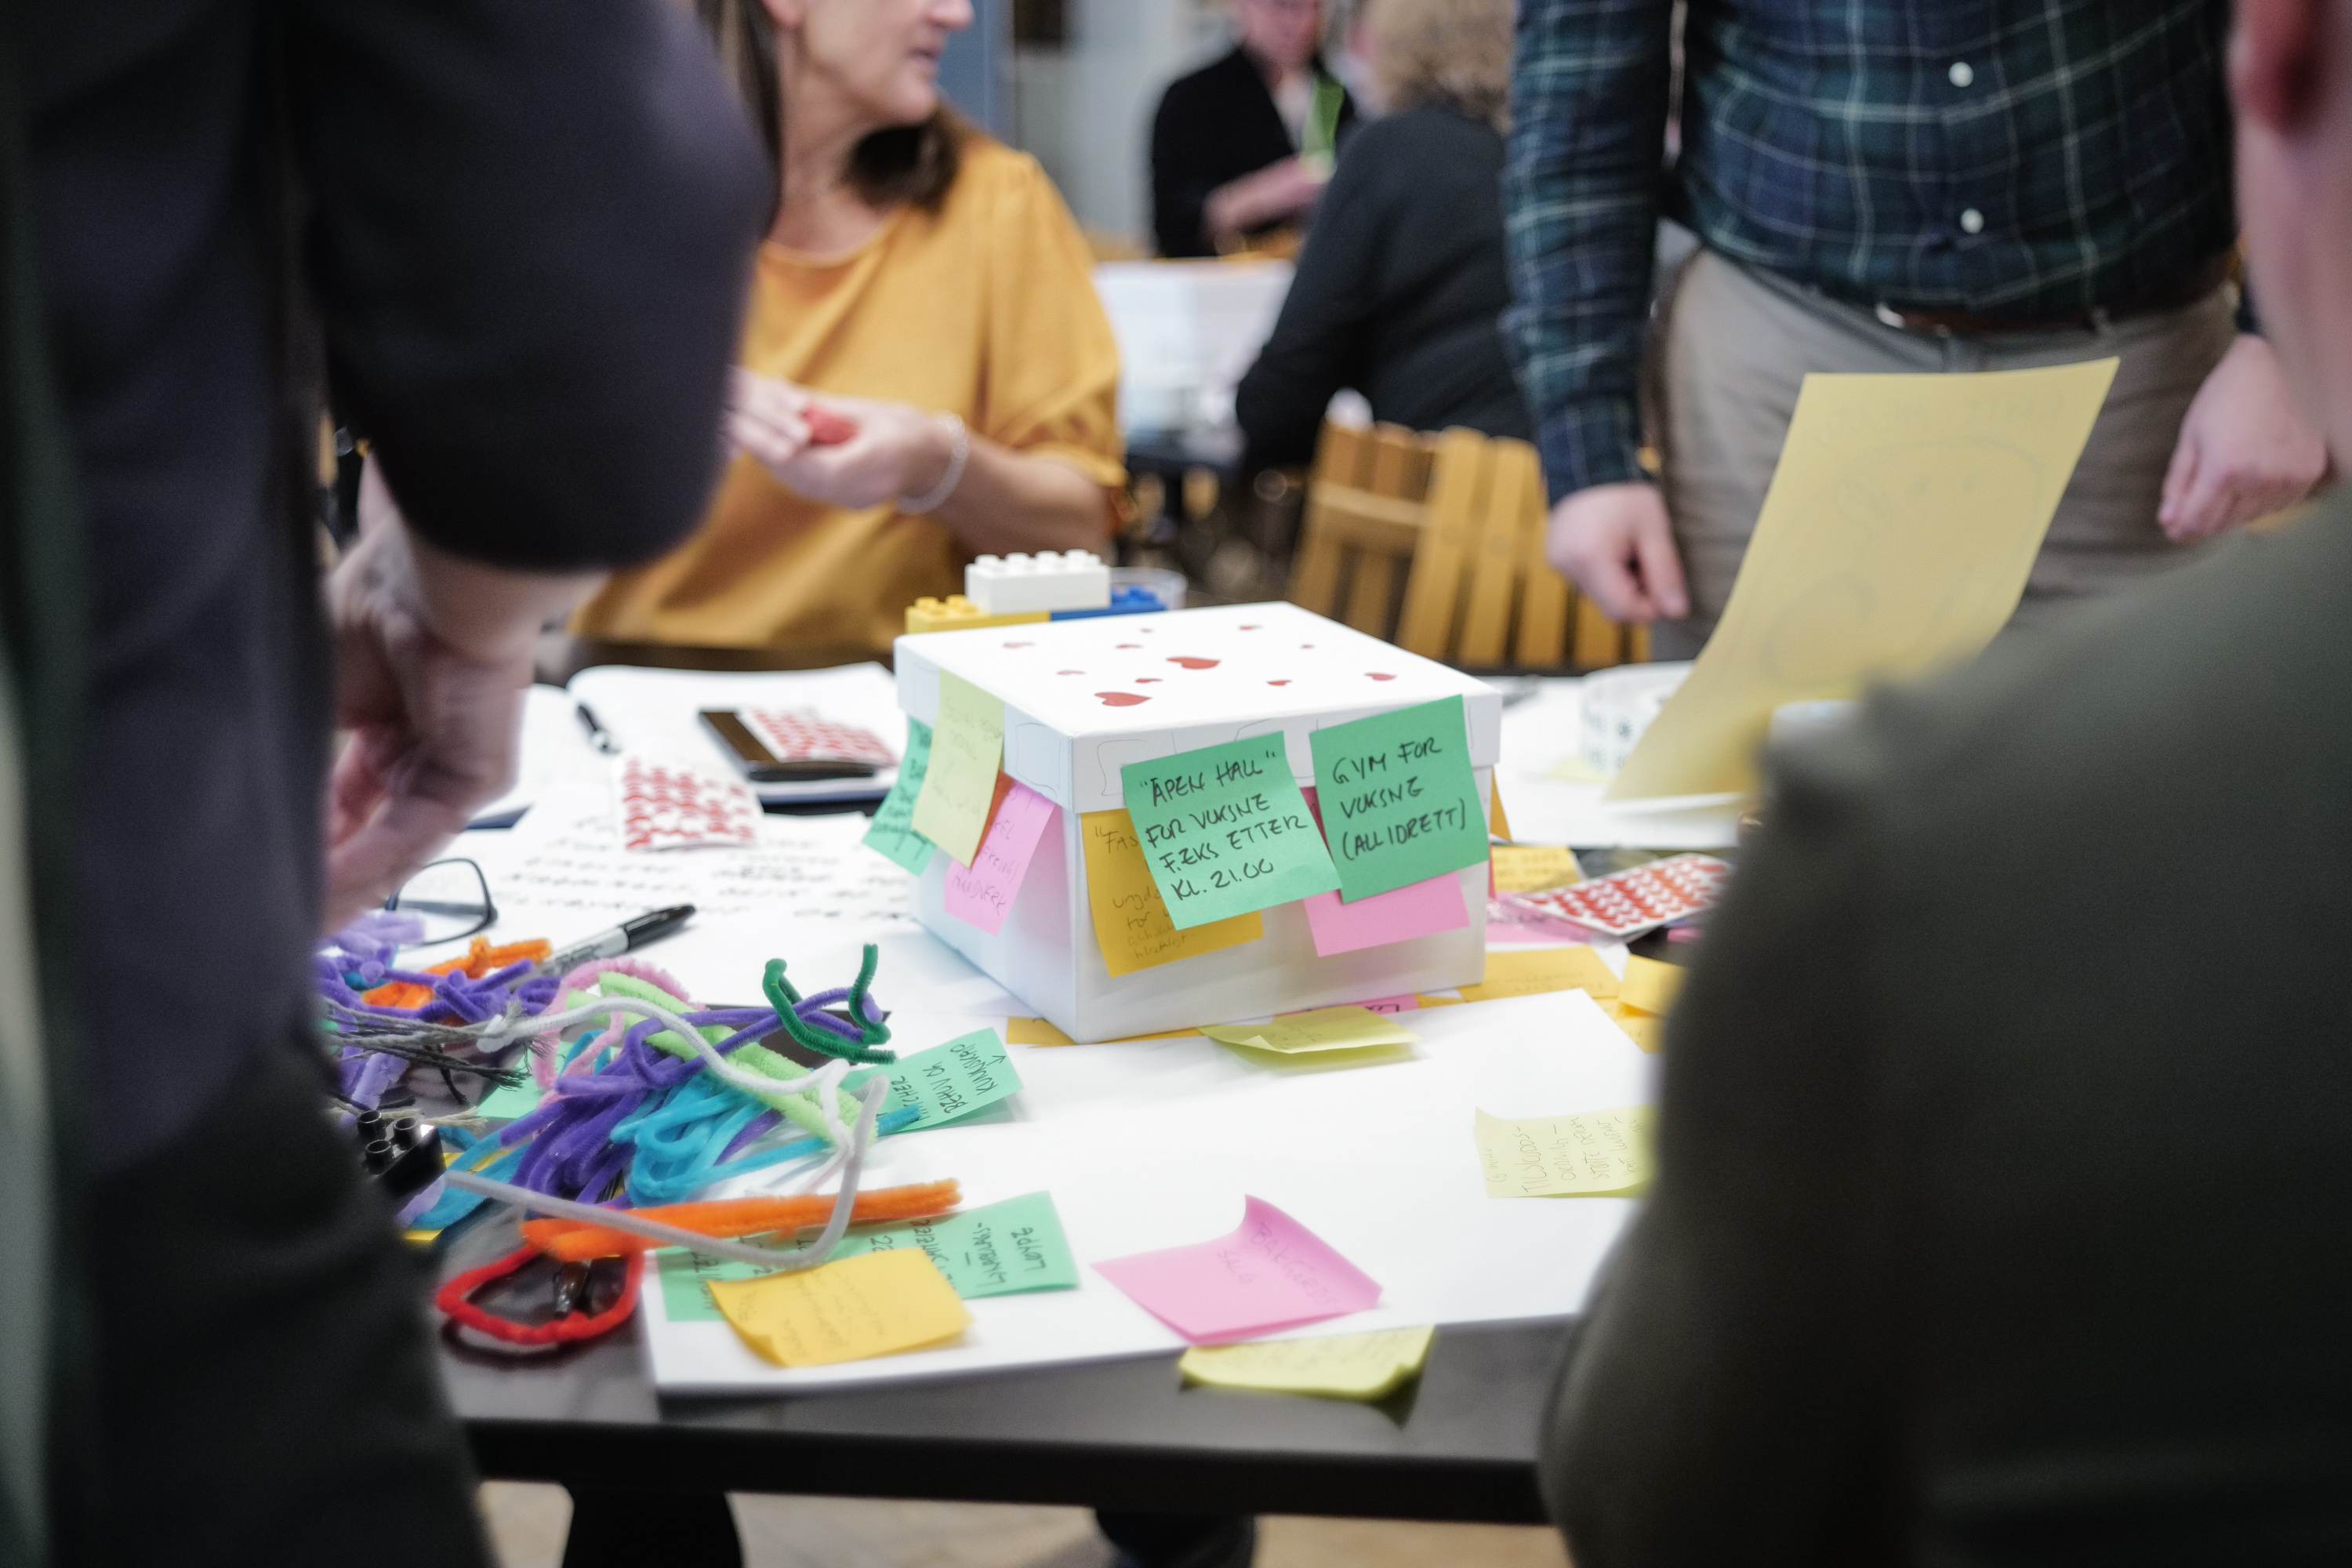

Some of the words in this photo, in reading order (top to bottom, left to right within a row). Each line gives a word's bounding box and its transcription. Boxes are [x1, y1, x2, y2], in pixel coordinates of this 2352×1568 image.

[1333, 751, 1387, 782] GYM
[1398, 736, 1443, 760] FOR
[1145, 818, 1187, 849] FOR
[1227, 814, 1308, 851] ETTER
[1171, 878, 1208, 901] KL.
[1210, 857, 1275, 888] 21.00
[950, 1044, 998, 1096] KUNNSKAP
[930, 1077, 969, 1114] BEHOV
